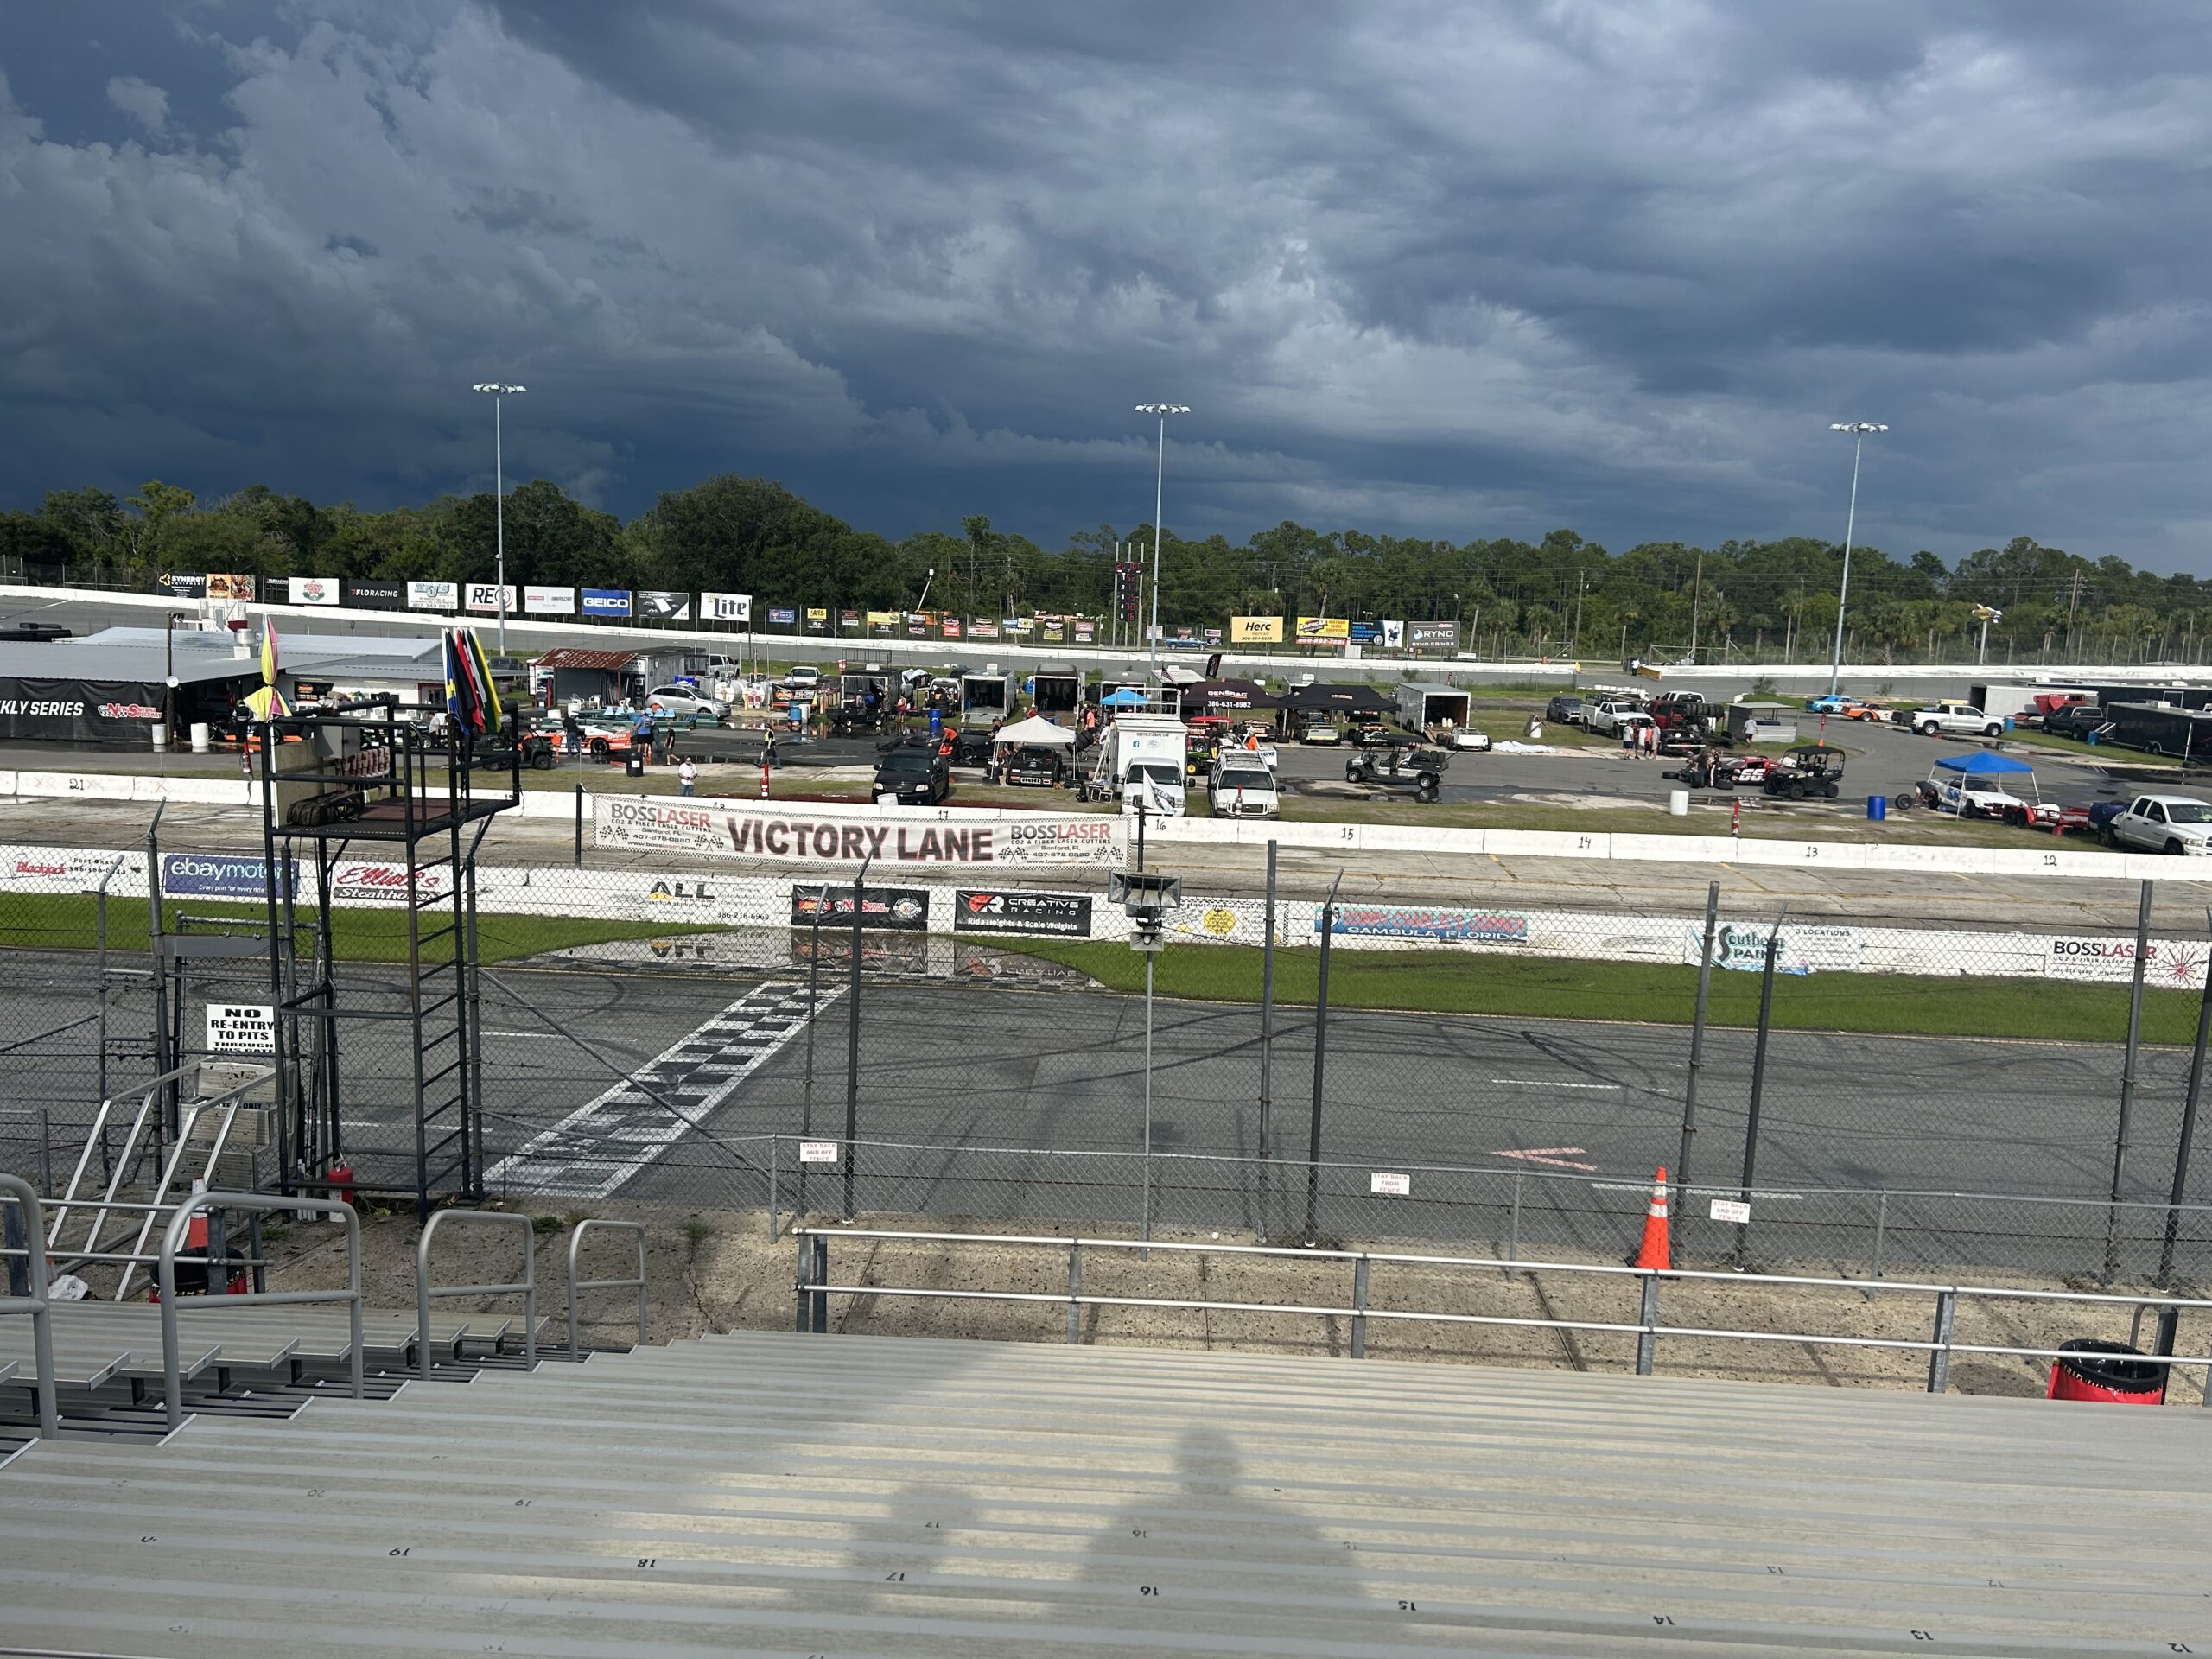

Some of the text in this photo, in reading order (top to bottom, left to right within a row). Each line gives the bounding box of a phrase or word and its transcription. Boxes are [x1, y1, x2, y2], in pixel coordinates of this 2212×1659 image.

[355, 588, 398, 598] FLORACING
[583, 598, 628, 608] GEICO
[713, 597, 747, 619] Lite
[1245, 621, 1272, 631] Herc
[1208, 690, 1248, 698] GENERAC
[29, 701, 85, 716] SERIES
[1738, 768, 1766, 781] 66
[68, 779, 85, 791] 21
[612, 804, 711, 828] BOSSLASER
[938, 810, 949, 820] 17
[1155, 818, 1166, 831] 16
[1011, 823, 1111, 839] BOSSLASER
[1340, 827, 1354, 840] 15
[727, 817, 993, 861] VICTORY LANE
[1579, 836, 1592, 849] 14
[1806, 846, 1818, 857] 13
[2044, 855, 2057, 866] 12
[16, 861, 67, 875] Blackjack
[48, 875, 87, 884] Sealcoating
[339, 888, 435, 901] Steakhose
[649, 881, 715, 900] ALL
[1008, 899, 1079, 908] CREATIVE
[1011, 907, 1076, 916] RACING
[986, 918, 1015, 927] Heights
[1046, 922, 1077, 931] Weights
[1347, 926, 1440, 938] SAMSULA,
[1719, 926, 1785, 961] Southen
[2053, 941, 2158, 959] BOSSLASR
[225, 1008, 261, 1018] NO
[211, 1020, 275, 1030] RE-ENTRY
[218, 1031, 269, 1040] TO PITS
[388, 1547, 410, 1557] 19
[636, 1558, 657, 1568] 18
[885, 1572, 906, 1582] 17
[1139, 1586, 1160, 1597] 16
[1398, 1600, 1417, 1611] 15
[1652, 1614, 1675, 1627] 14
[1910, 1630, 1935, 1641] 13
[2166, 1642, 2193, 1654] 12
